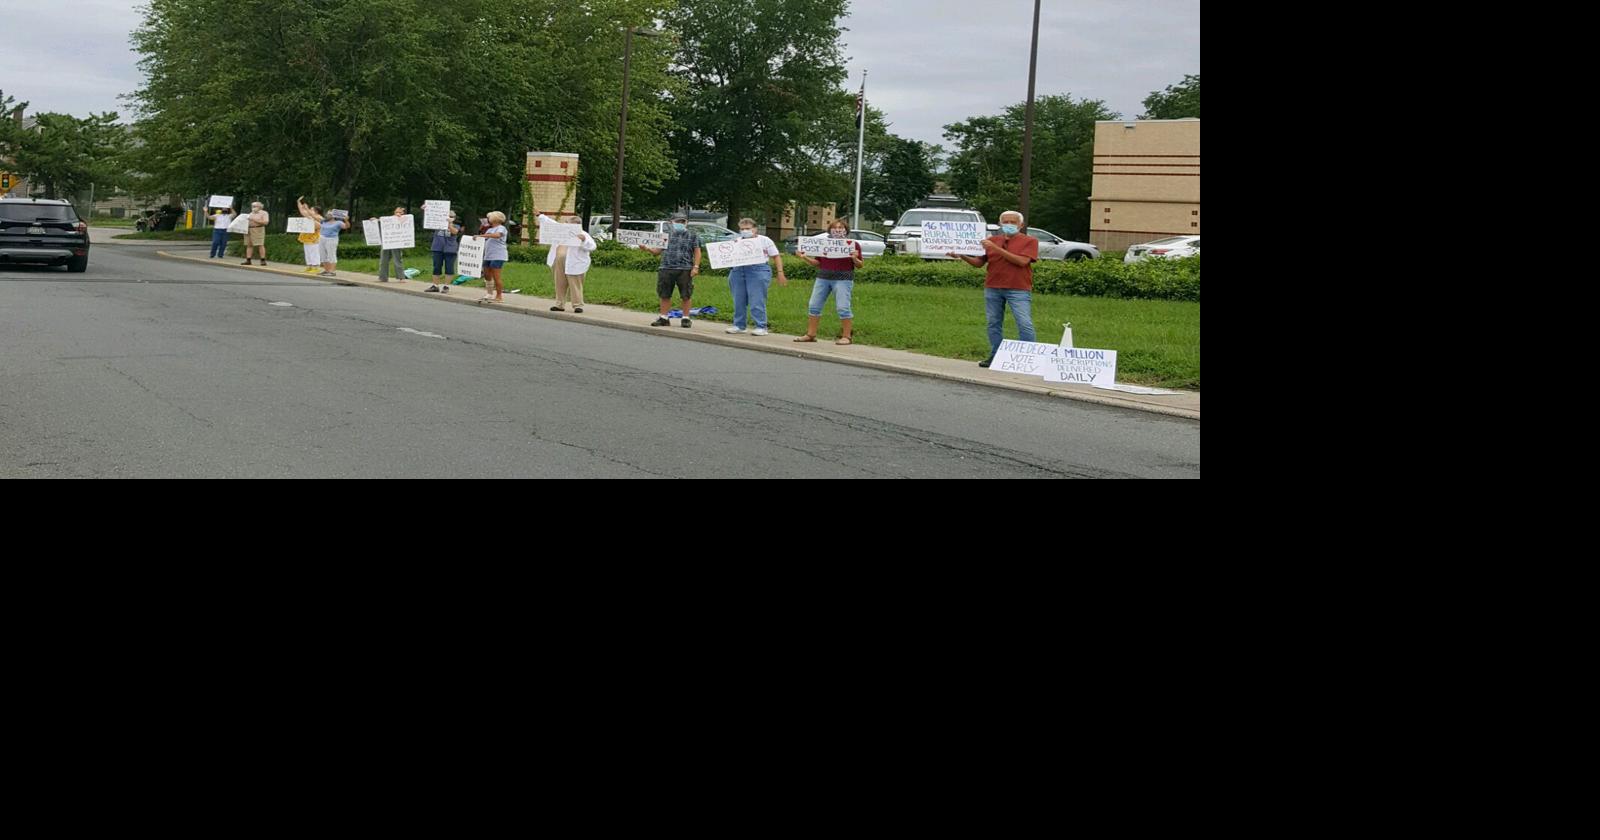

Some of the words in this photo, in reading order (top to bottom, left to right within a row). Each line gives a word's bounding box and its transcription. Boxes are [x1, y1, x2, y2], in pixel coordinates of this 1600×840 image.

[924, 221, 937, 230] 46
[940, 222, 977, 231] MILLION
[802, 237, 825, 246] SAVE
[800, 245, 820, 253] POST
[1010, 353, 1035, 364] VOTE
[1051, 348, 1058, 357] 4
[1064, 349, 1104, 360] MILLION
[1001, 361, 1039, 373] EARLY
[1060, 372, 1096, 382] DAILY
